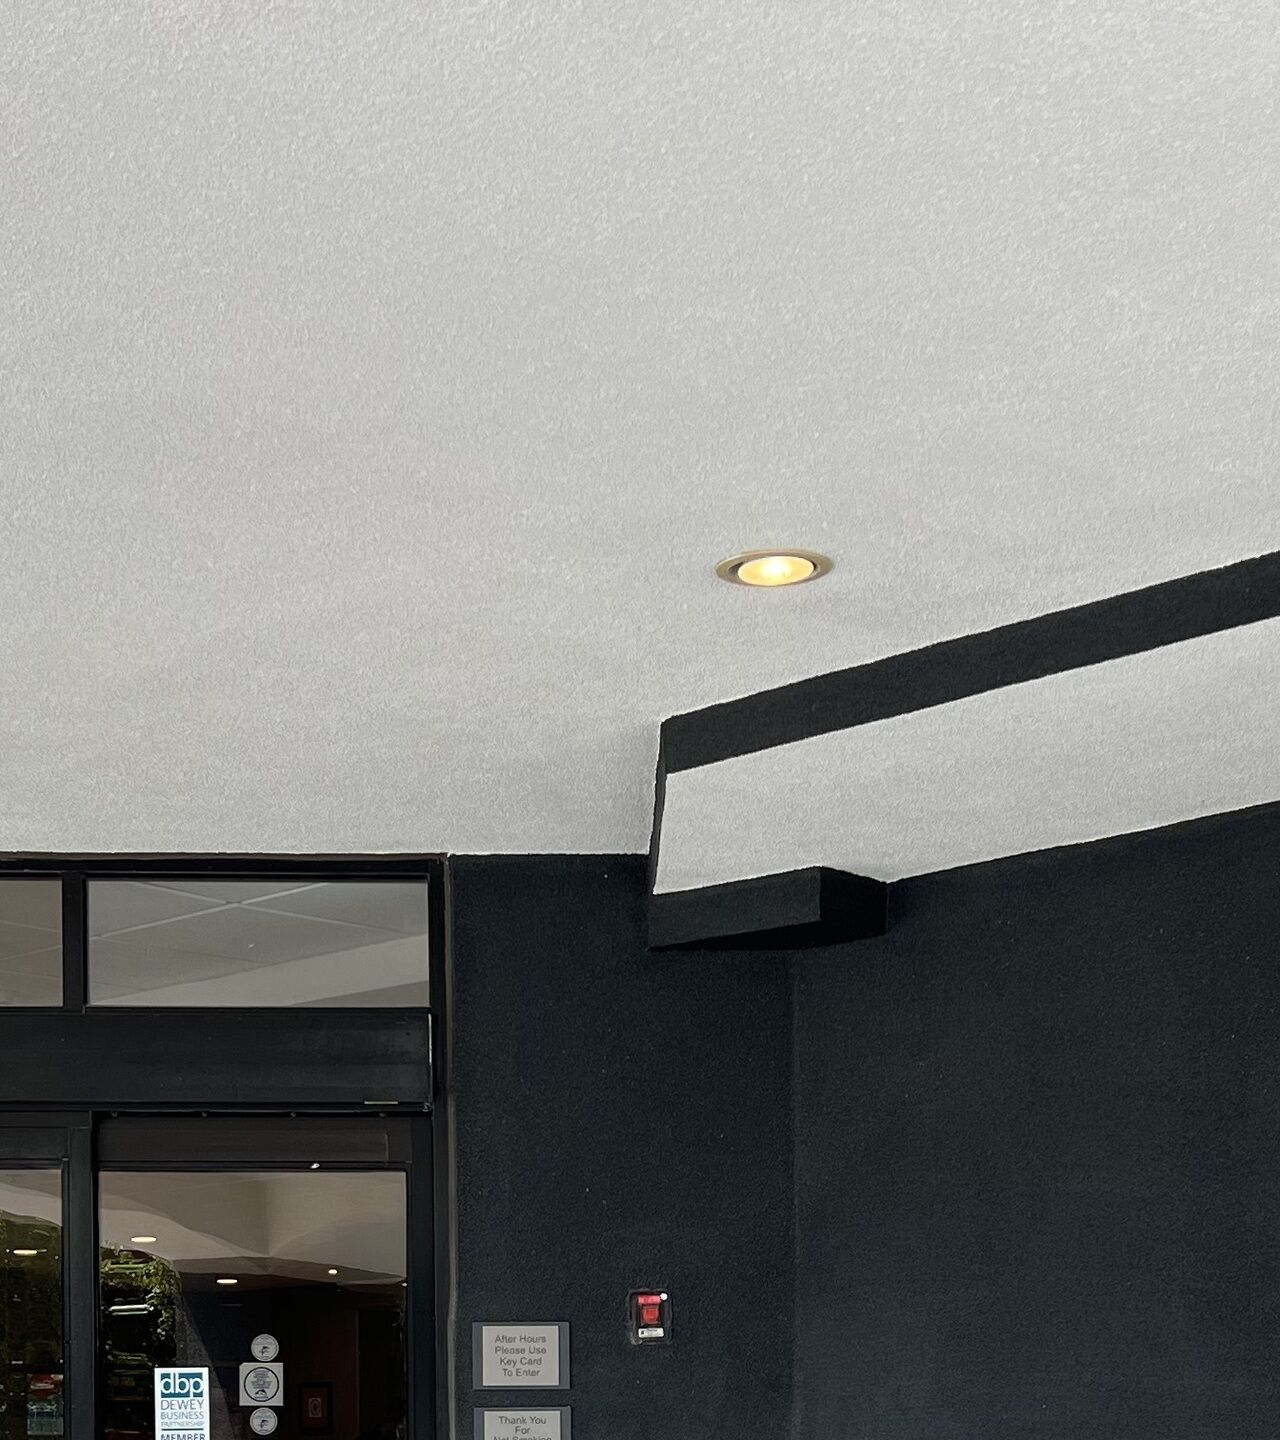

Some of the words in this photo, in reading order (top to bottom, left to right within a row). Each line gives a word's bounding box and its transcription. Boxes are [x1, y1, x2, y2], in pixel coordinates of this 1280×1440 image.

[495, 1334, 516, 1343] After
[519, 1334, 546, 1343] Hours
[495, 1346, 525, 1355] Please
[529, 1346, 547, 1355] Use
[500, 1357, 517, 1368] Key
[520, 1357, 542, 1366] Card
[502, 1368, 513, 1377] To
[516, 1368, 540, 1377] Enter
[161, 1372, 204, 1398] dbp
[160, 1399, 205, 1411] DEWEY
[160, 1411, 205, 1420] BUSINESS
[498, 1416, 527, 1425] Thank
[529, 1416, 547, 1425] You
[514, 1426, 530, 1435] For
